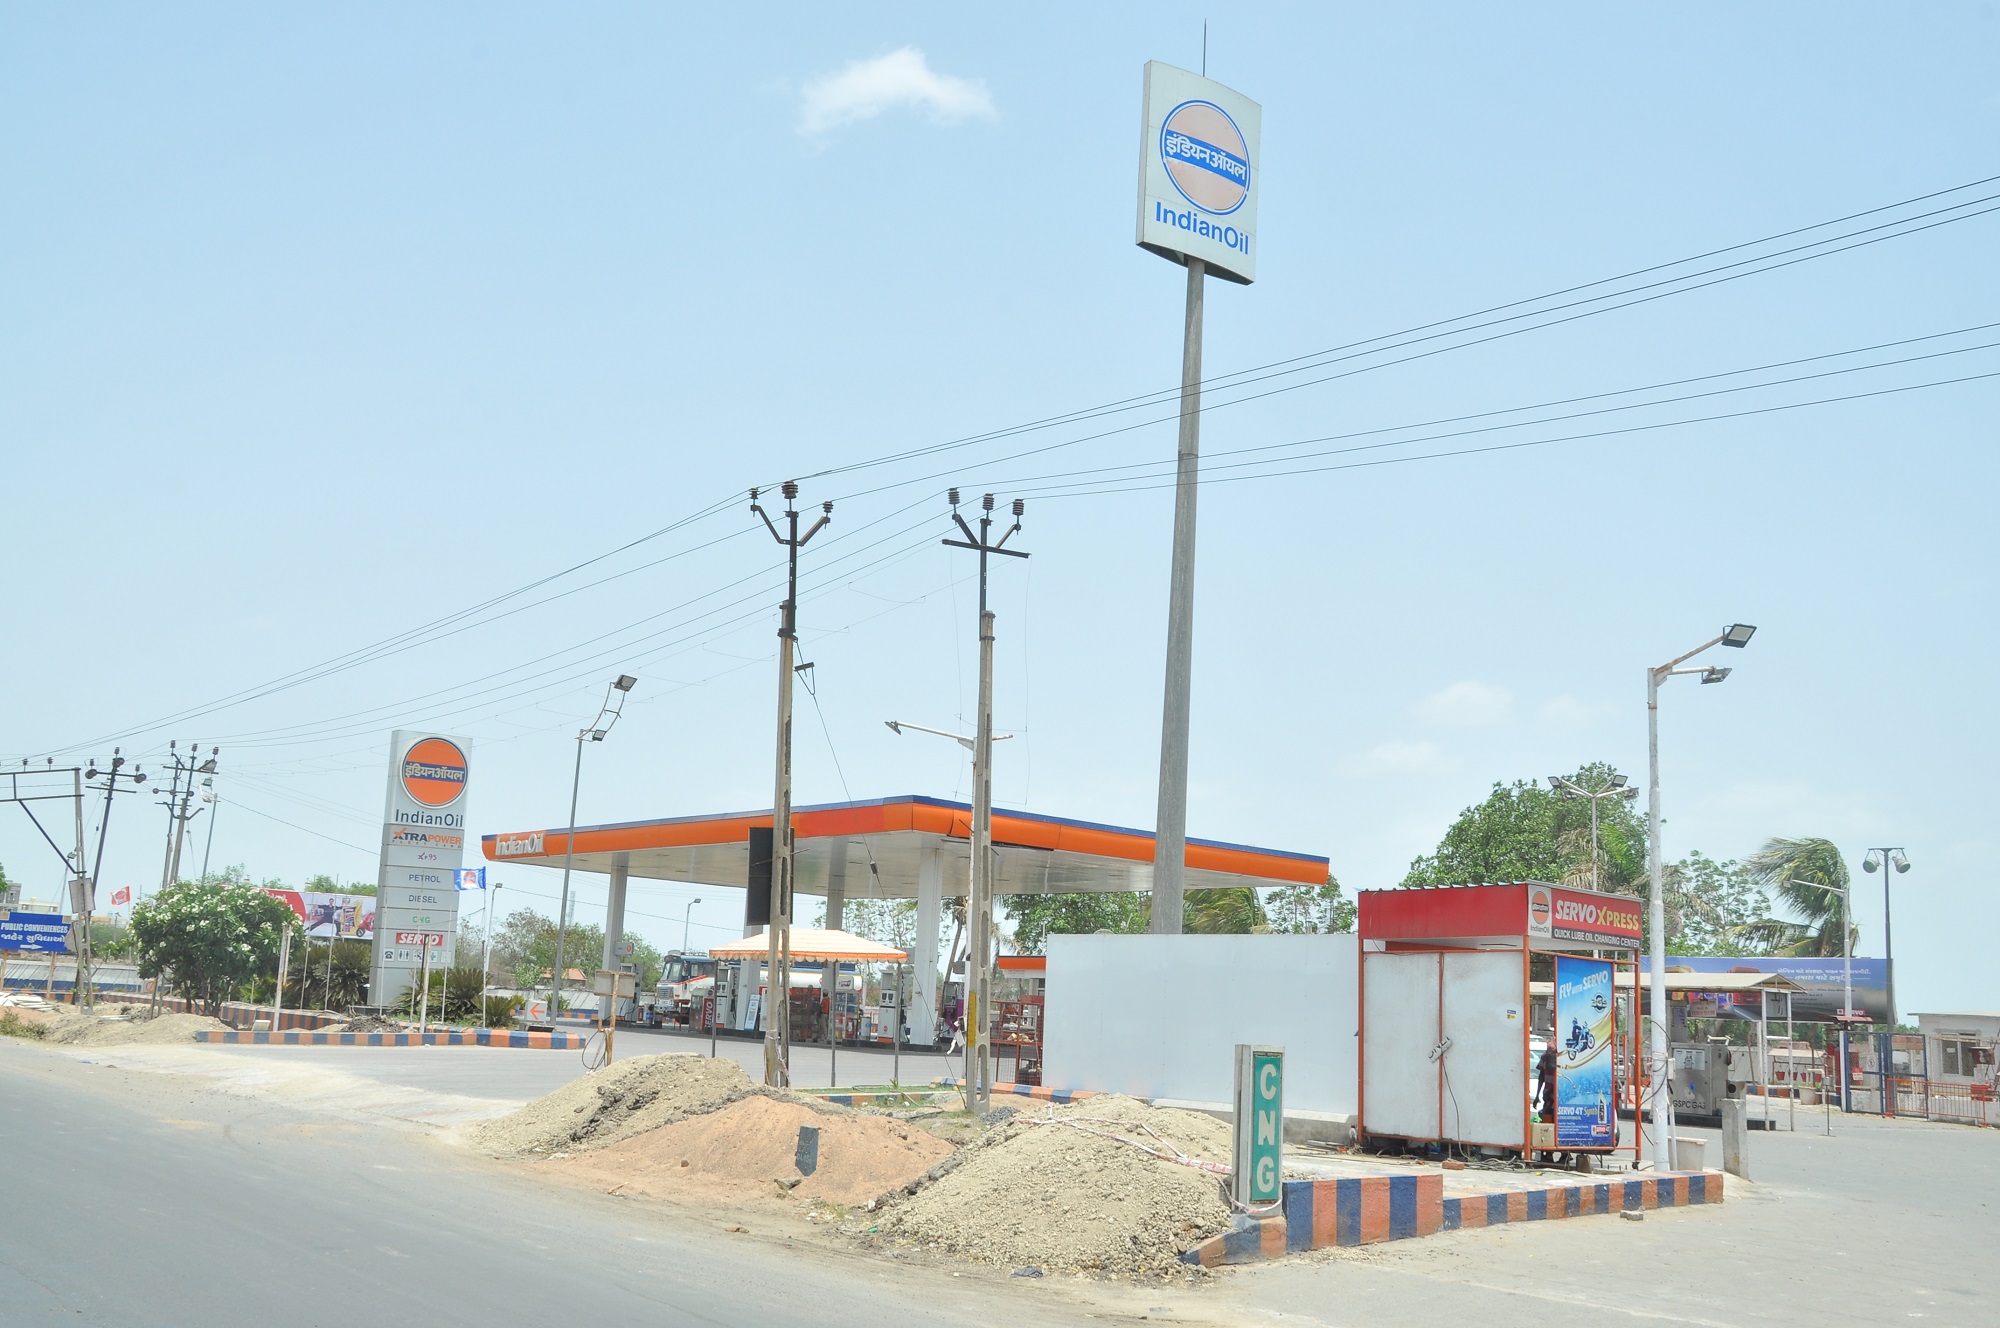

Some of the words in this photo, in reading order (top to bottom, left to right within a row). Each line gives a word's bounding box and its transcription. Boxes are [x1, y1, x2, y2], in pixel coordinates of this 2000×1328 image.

[1165, 132, 1247, 181] इंडियनऑयल
[1155, 201, 1250, 255] IndianOil
[404, 762, 464, 780] इंडियनऑयल
[395, 808, 464, 828] IndianOil
[393, 827, 462, 845] XTRAPOWER
[495, 833, 544, 856] IndianOil
[408, 873, 441, 883] PETROL
[408, 894, 438, 904] DIESEL
[1555, 899, 1597, 924] SERVO
[1596, 905, 1639, 931] XPRESS
[1, 922, 24, 931] PUBLIC
[23, 923, 68, 934] CONVENIENCES
[1554, 928, 1571, 939] QUICK
[1571, 930, 1585, 941] LUBE
[1585, 932, 1594, 942] OIL
[1594, 934, 1620, 946] CHANGING
[1620, 938, 1640, 948] CENTER
[1559, 982, 1572, 1000] FLY
[1582, 970, 1609, 990] SERVO
[1558, 1106, 1575, 1116] SERVO
[1575, 1107, 1584, 1116] 4T
[1672, 1099, 1691, 1109] GSPC
[1256, 1063, 1277, 1193] CNG
